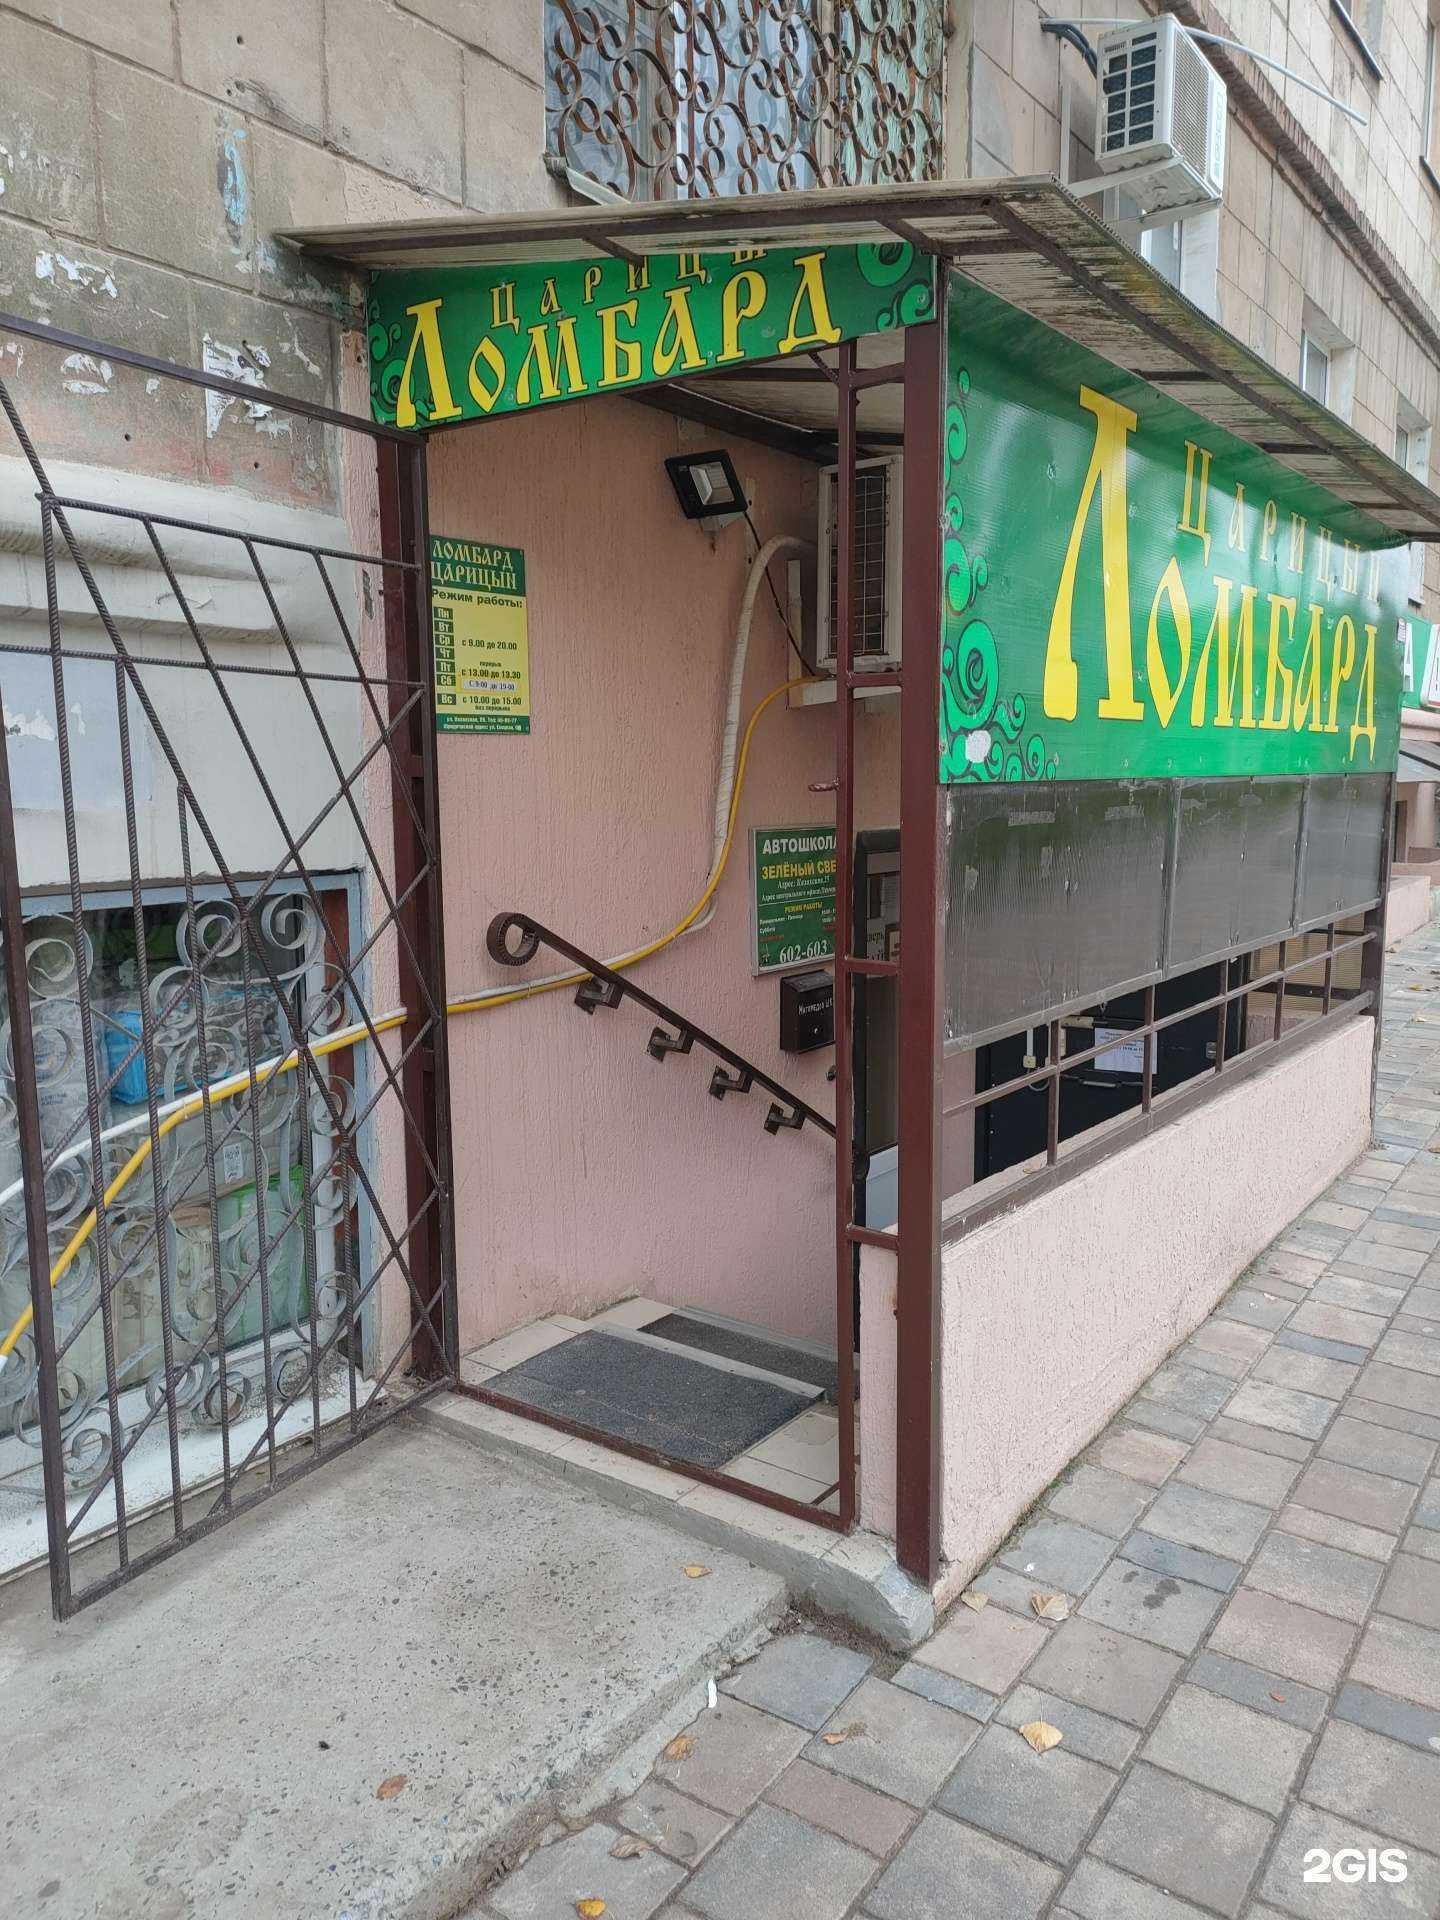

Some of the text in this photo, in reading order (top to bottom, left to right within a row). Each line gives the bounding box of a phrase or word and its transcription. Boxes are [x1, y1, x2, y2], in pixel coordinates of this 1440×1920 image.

[396, 252, 842, 429] ЛОМБАРД
[432, 540, 513, 572] ЛОМБАРД
[430, 561, 518, 591] ЦАРИЦЫН
[1043, 383, 1377, 762] ЛОМБАРД
[432, 588, 523, 608] Режим работы:
[437, 607, 450, 619] Пн
[438, 621, 450, 633] Вт
[439, 634, 451, 646] Ср
[486, 641, 496, 650] до
[497, 641, 518, 650] 20.00
[440, 647, 451, 658] Чт
[440, 661, 451, 672] Пт
[440, 674, 452, 685] Сб
[468, 668, 490, 677] 13.00
[490, 671, 500, 679] до
[501, 670, 522, 679] 13.30
[441, 694, 453, 704] Вс
[469, 695, 490, 704] 10.00
[491, 697, 501, 705] до
[502, 697, 522, 706] 15.00
[762, 859, 837, 880] ЗЕЛЁНЫЙ СВЕ
[780, 939, 828, 964] 602-603
